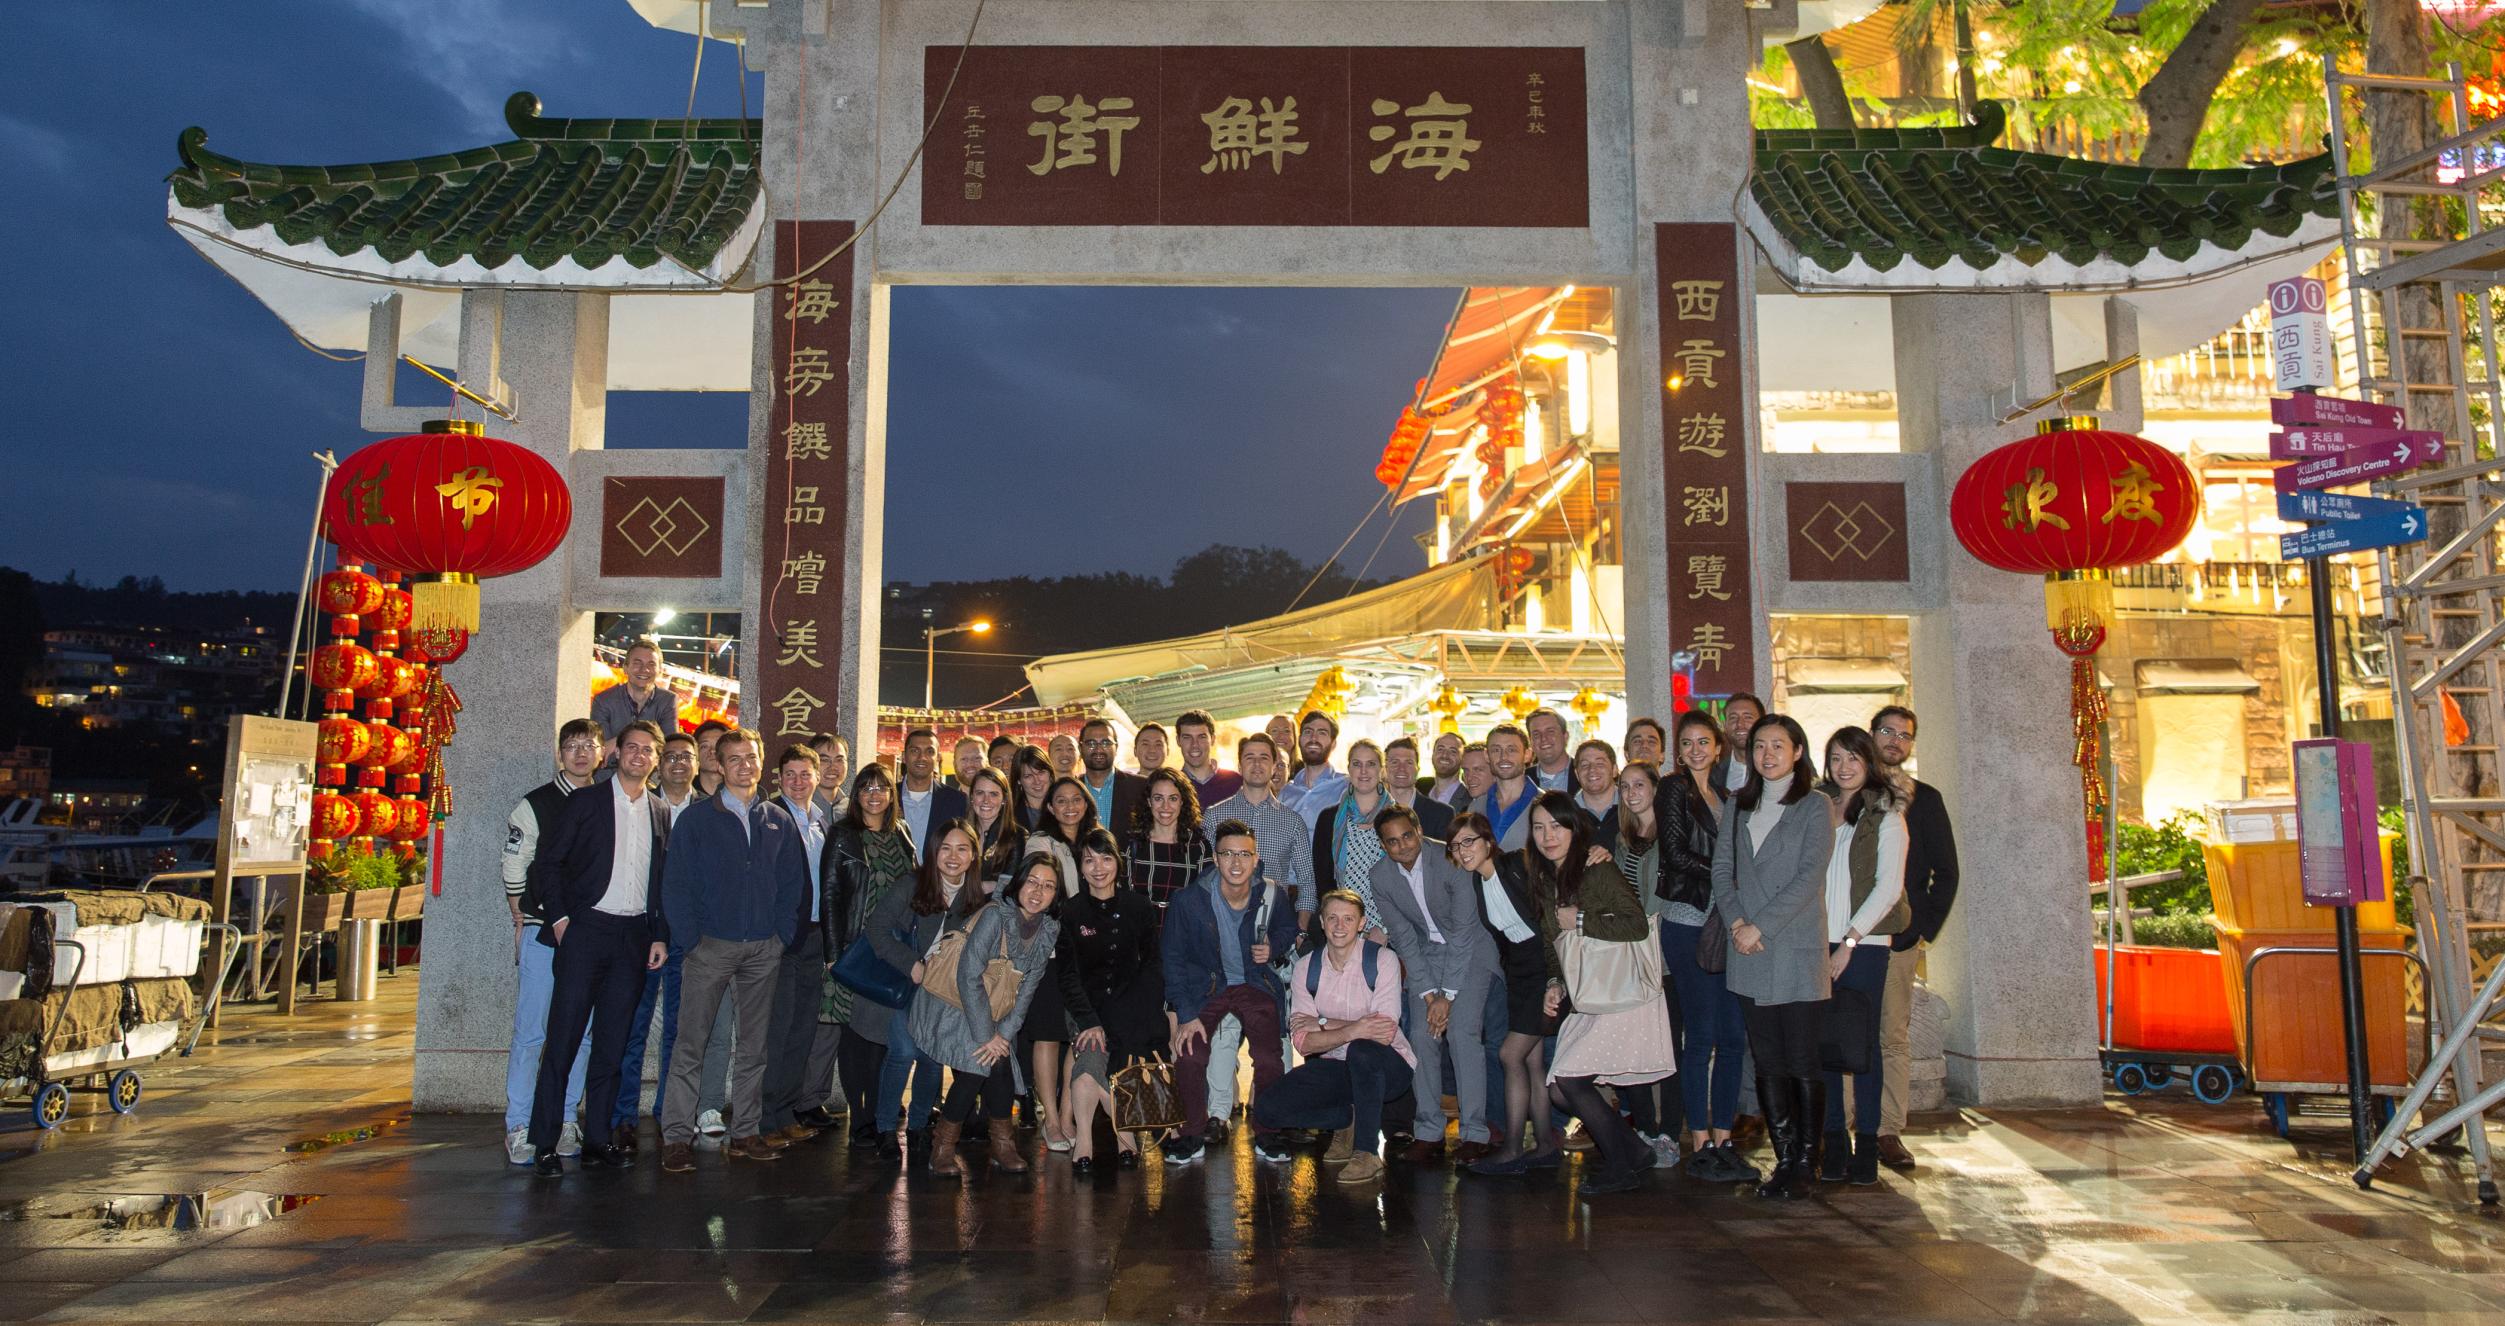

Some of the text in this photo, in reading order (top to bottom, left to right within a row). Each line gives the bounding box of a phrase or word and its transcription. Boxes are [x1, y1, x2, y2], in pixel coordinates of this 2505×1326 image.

[2275, 324, 2302, 381] 西貢
[2312, 320, 2324, 379] Sai Kung
[2315, 411, 2373, 425] Sai Kung Old Town
[2312, 443, 2326, 452] Tin
[2328, 443, 2345, 452] Hau
[2297, 459, 2390, 486] Volcano Discovery Centre
[2321, 508, 2361, 520] Public Toilet
[2301, 539, 2350, 554] Bus Terminus
